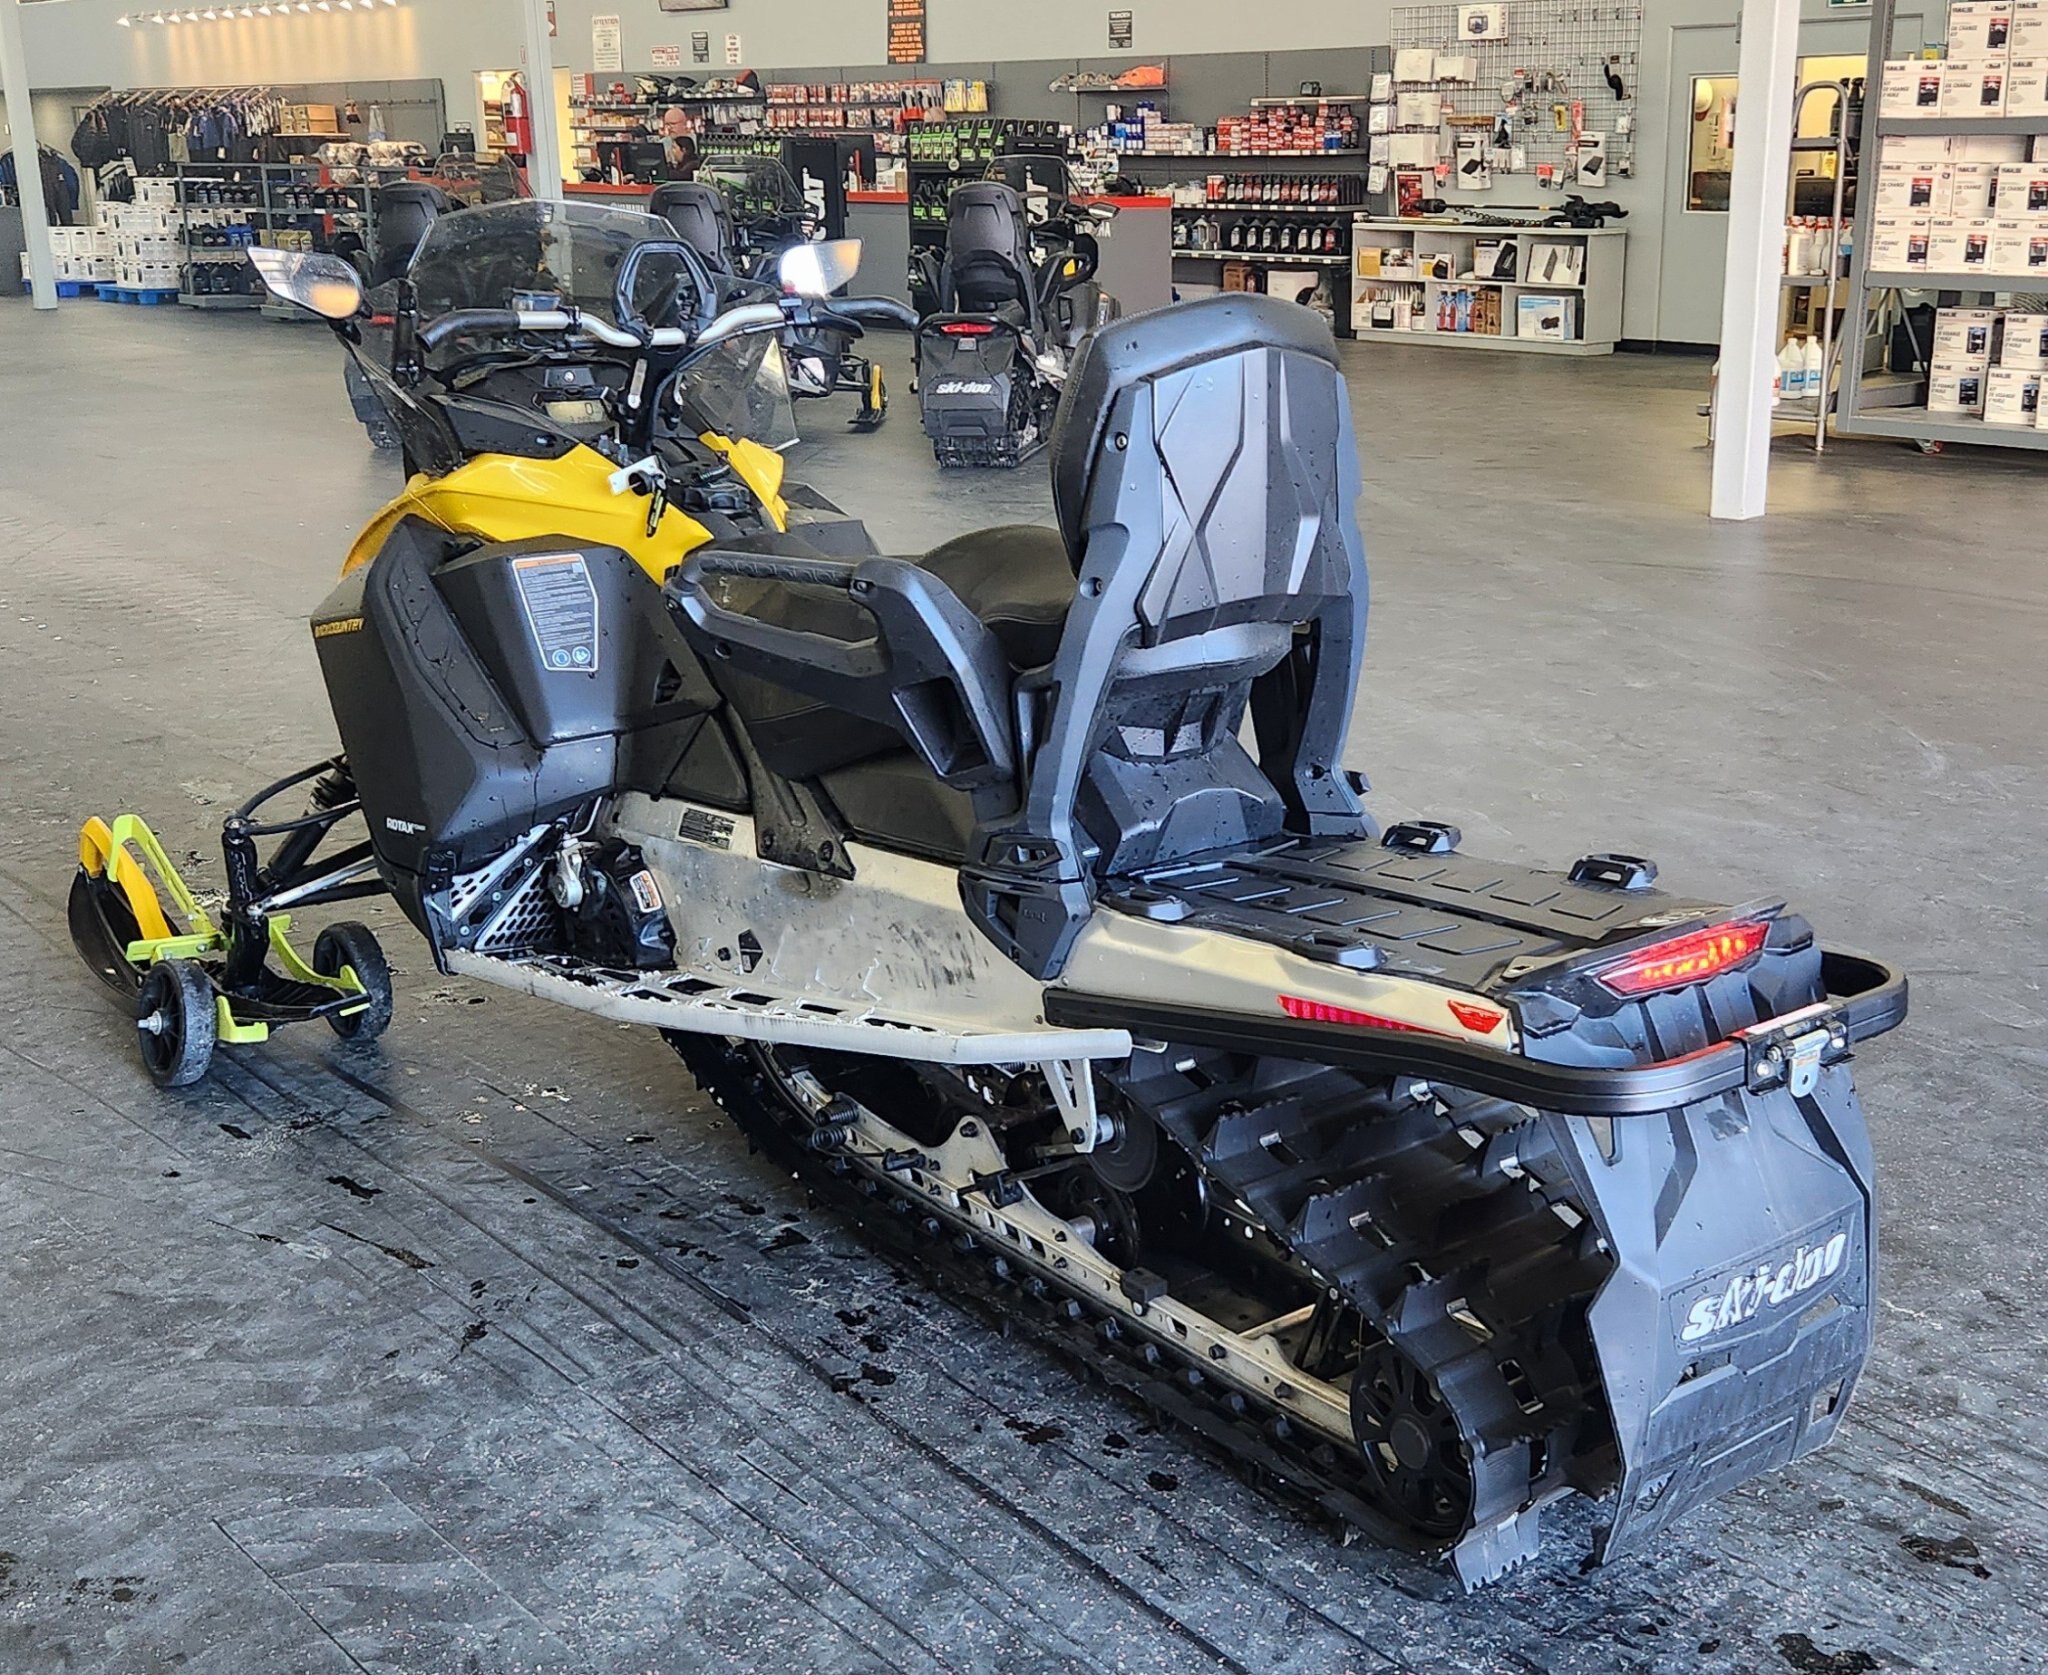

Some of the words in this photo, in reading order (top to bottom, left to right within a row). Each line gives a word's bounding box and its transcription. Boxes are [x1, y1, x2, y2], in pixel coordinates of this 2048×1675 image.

[936, 381, 992, 394] ski-doo
[386, 817, 414, 834] ROTAX
[1681, 1232, 1846, 1341] ski-doo
